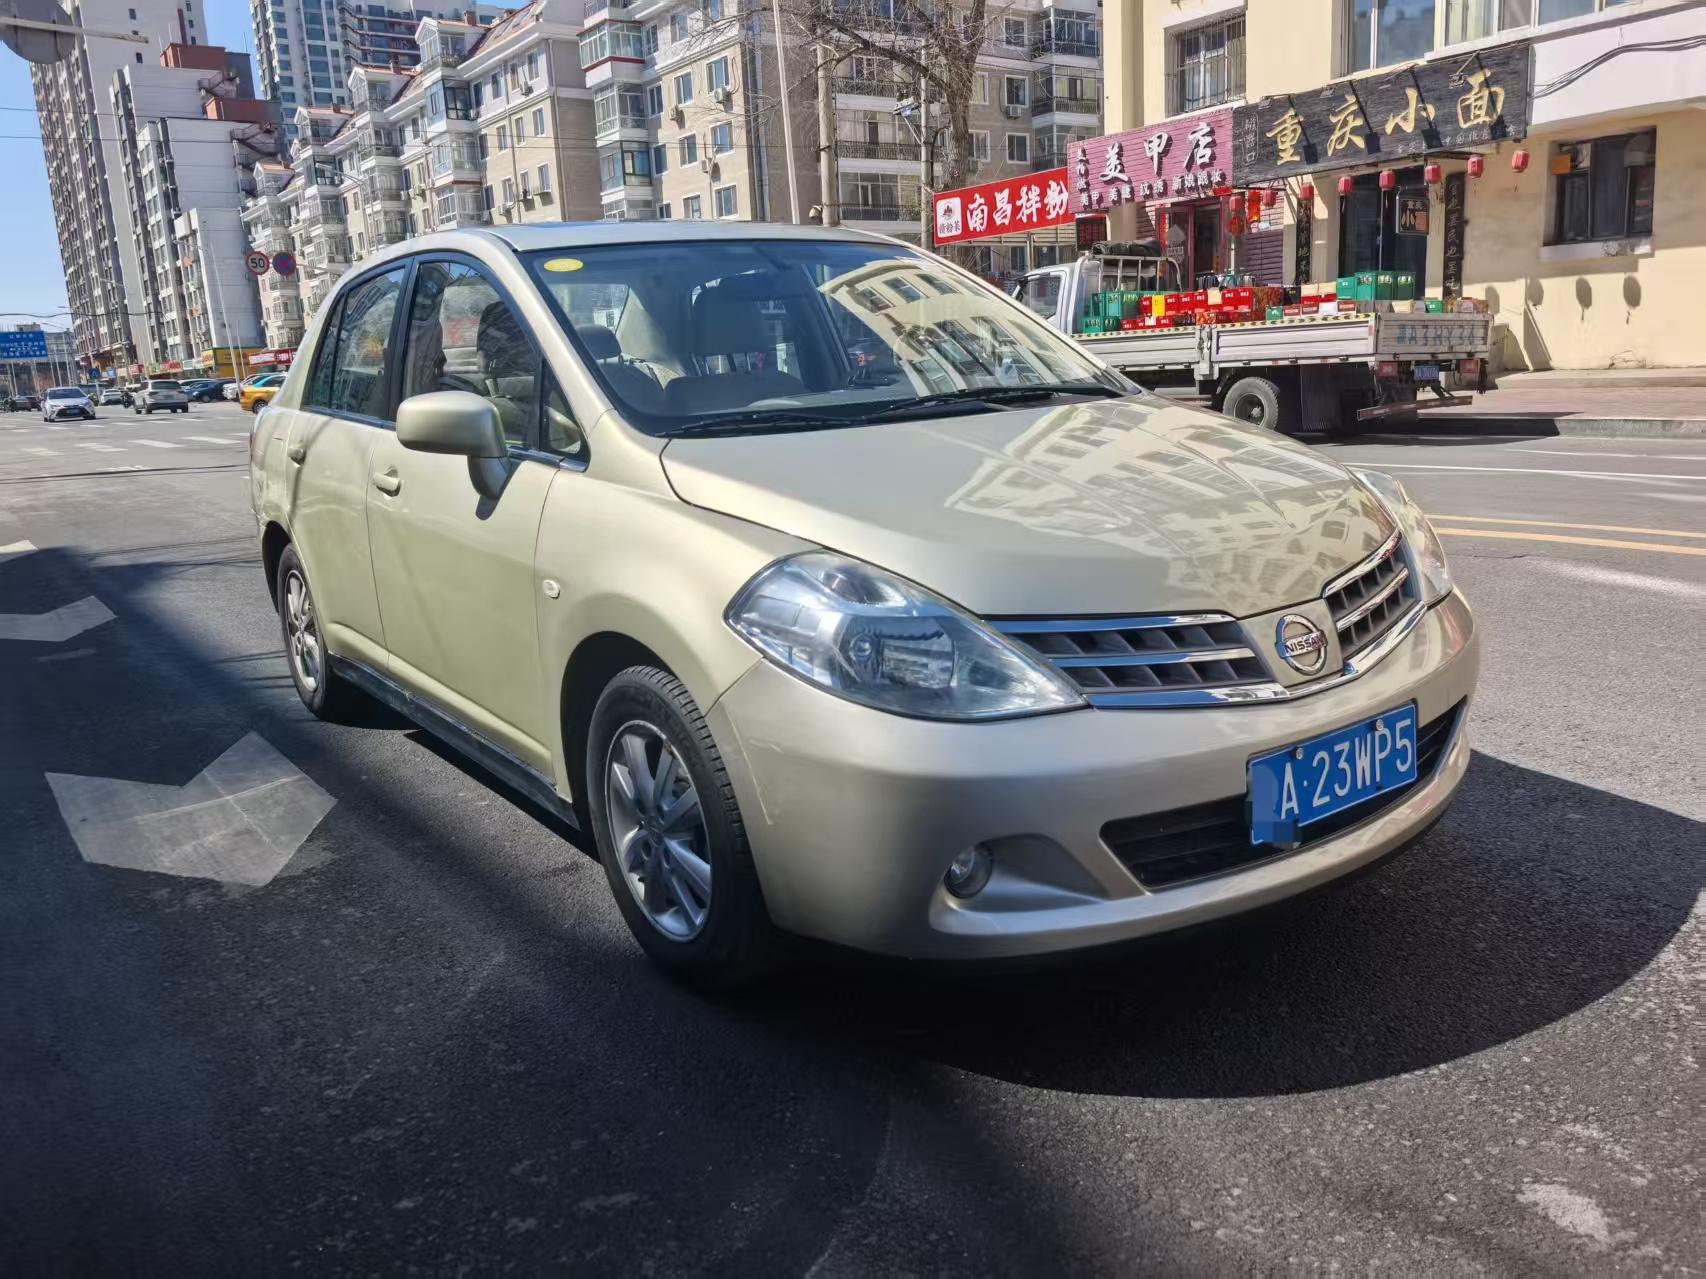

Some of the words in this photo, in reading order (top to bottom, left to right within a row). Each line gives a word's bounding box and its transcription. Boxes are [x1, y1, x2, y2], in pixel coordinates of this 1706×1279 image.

[1265, 68, 1505, 166] 重庆小面
[1100, 121, 1214, 182] 美甲店
[966, 180, 1069, 233] 南昌拌粉
[251, 258, 265, 269] 50
